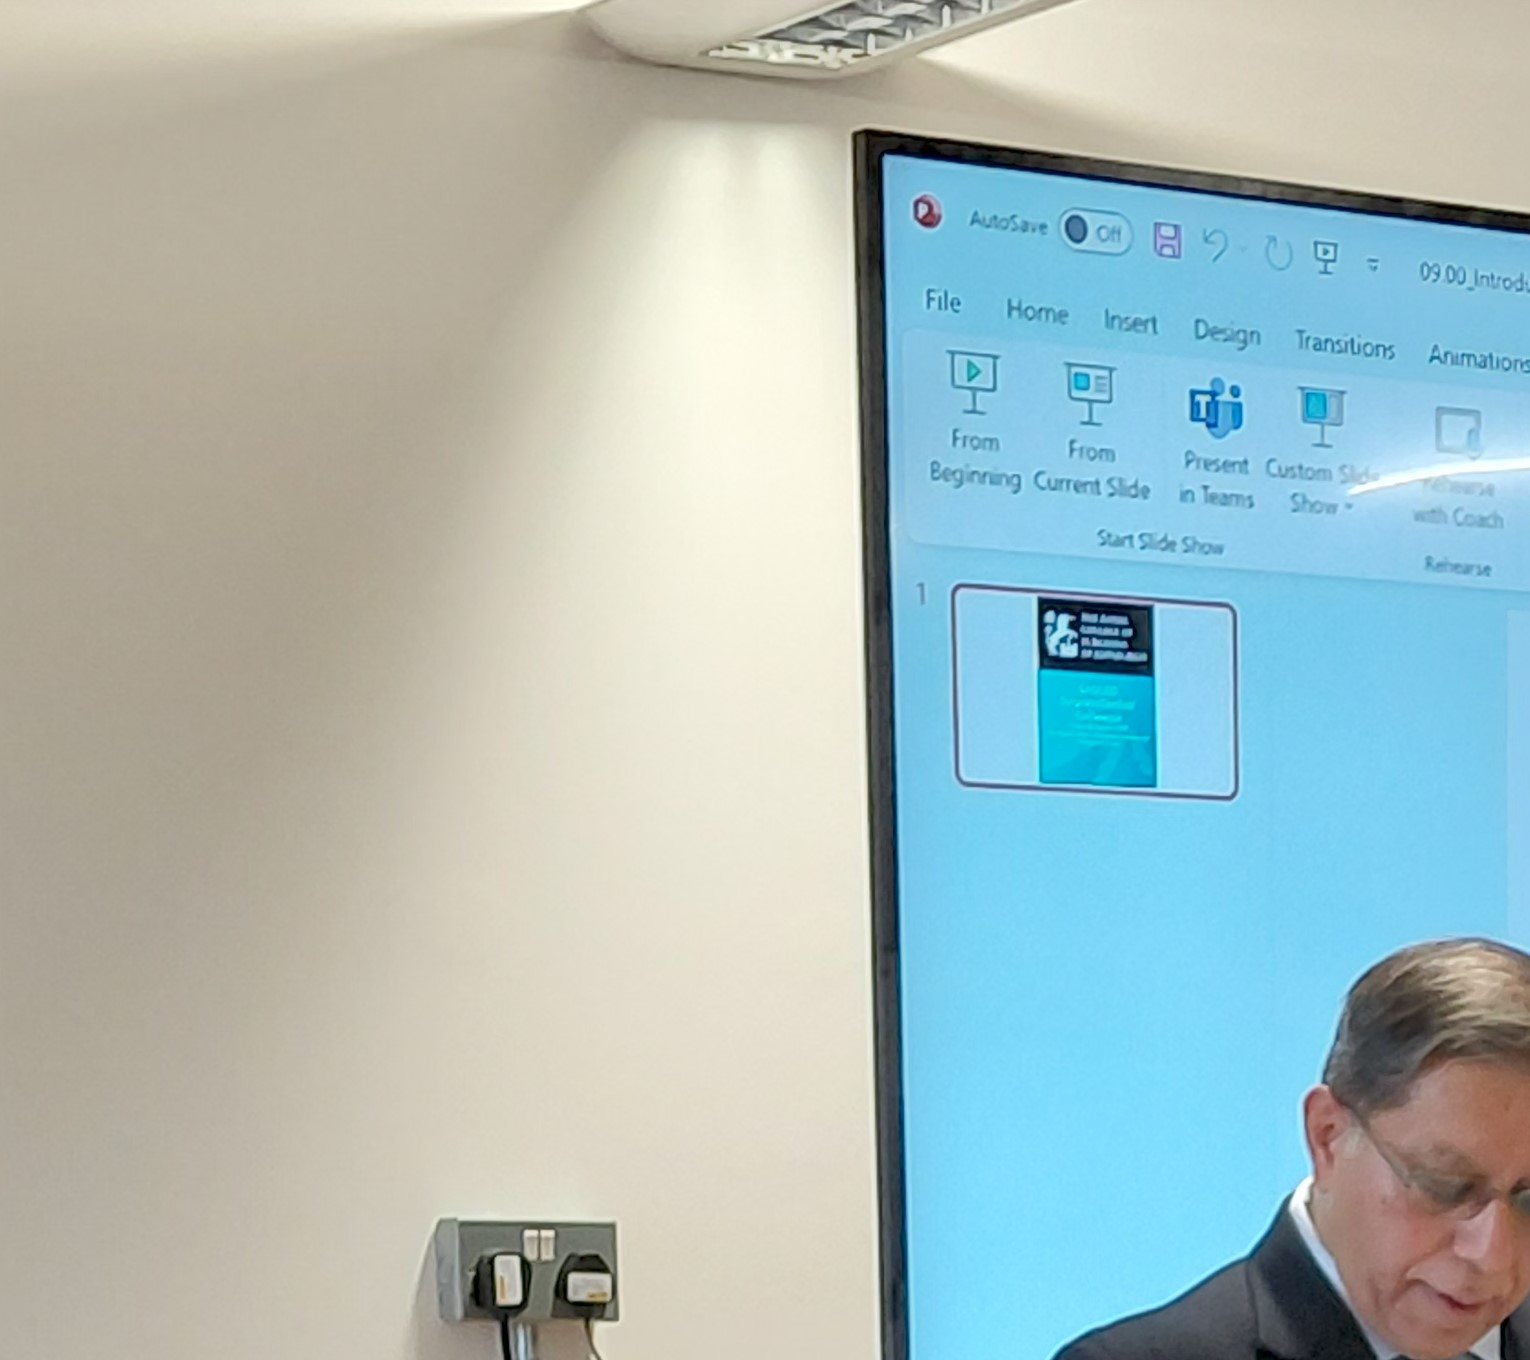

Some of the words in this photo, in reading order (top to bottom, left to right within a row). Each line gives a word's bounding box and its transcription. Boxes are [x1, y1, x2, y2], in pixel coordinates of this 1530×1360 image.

[969, 209, 1048, 236] AutoSave
[1097, 225, 1122, 244] Off
[926, 289, 961, 313] File
[1007, 299, 1069, 325] Home
[1105, 309, 1158, 335] Insert
[1195, 319, 1261, 348] Design
[1296, 330, 1396, 360] Transitions
[952, 429, 999, 453] From
[1069, 440, 1115, 463] From
[1185, 451, 1249, 475] Present
[1266, 459, 1332, 483] Custom
[931, 461, 1021, 494] Beginning
[1034, 471, 1100, 497] Current
[1107, 477, 1151, 501] Slide
[1180, 484, 1195, 502] in
[1202, 485, 1254, 509] Teams
[1290, 493, 1338, 516] Show
[1454, 506, 1504, 529] Coach
[1098, 529, 1136, 550] Start
[1139, 532, 1177, 554] Slide
[1181, 537, 1225, 557] Show
[1424, 555, 1493, 578] Rehearse
[916, 582, 926, 605] 1
